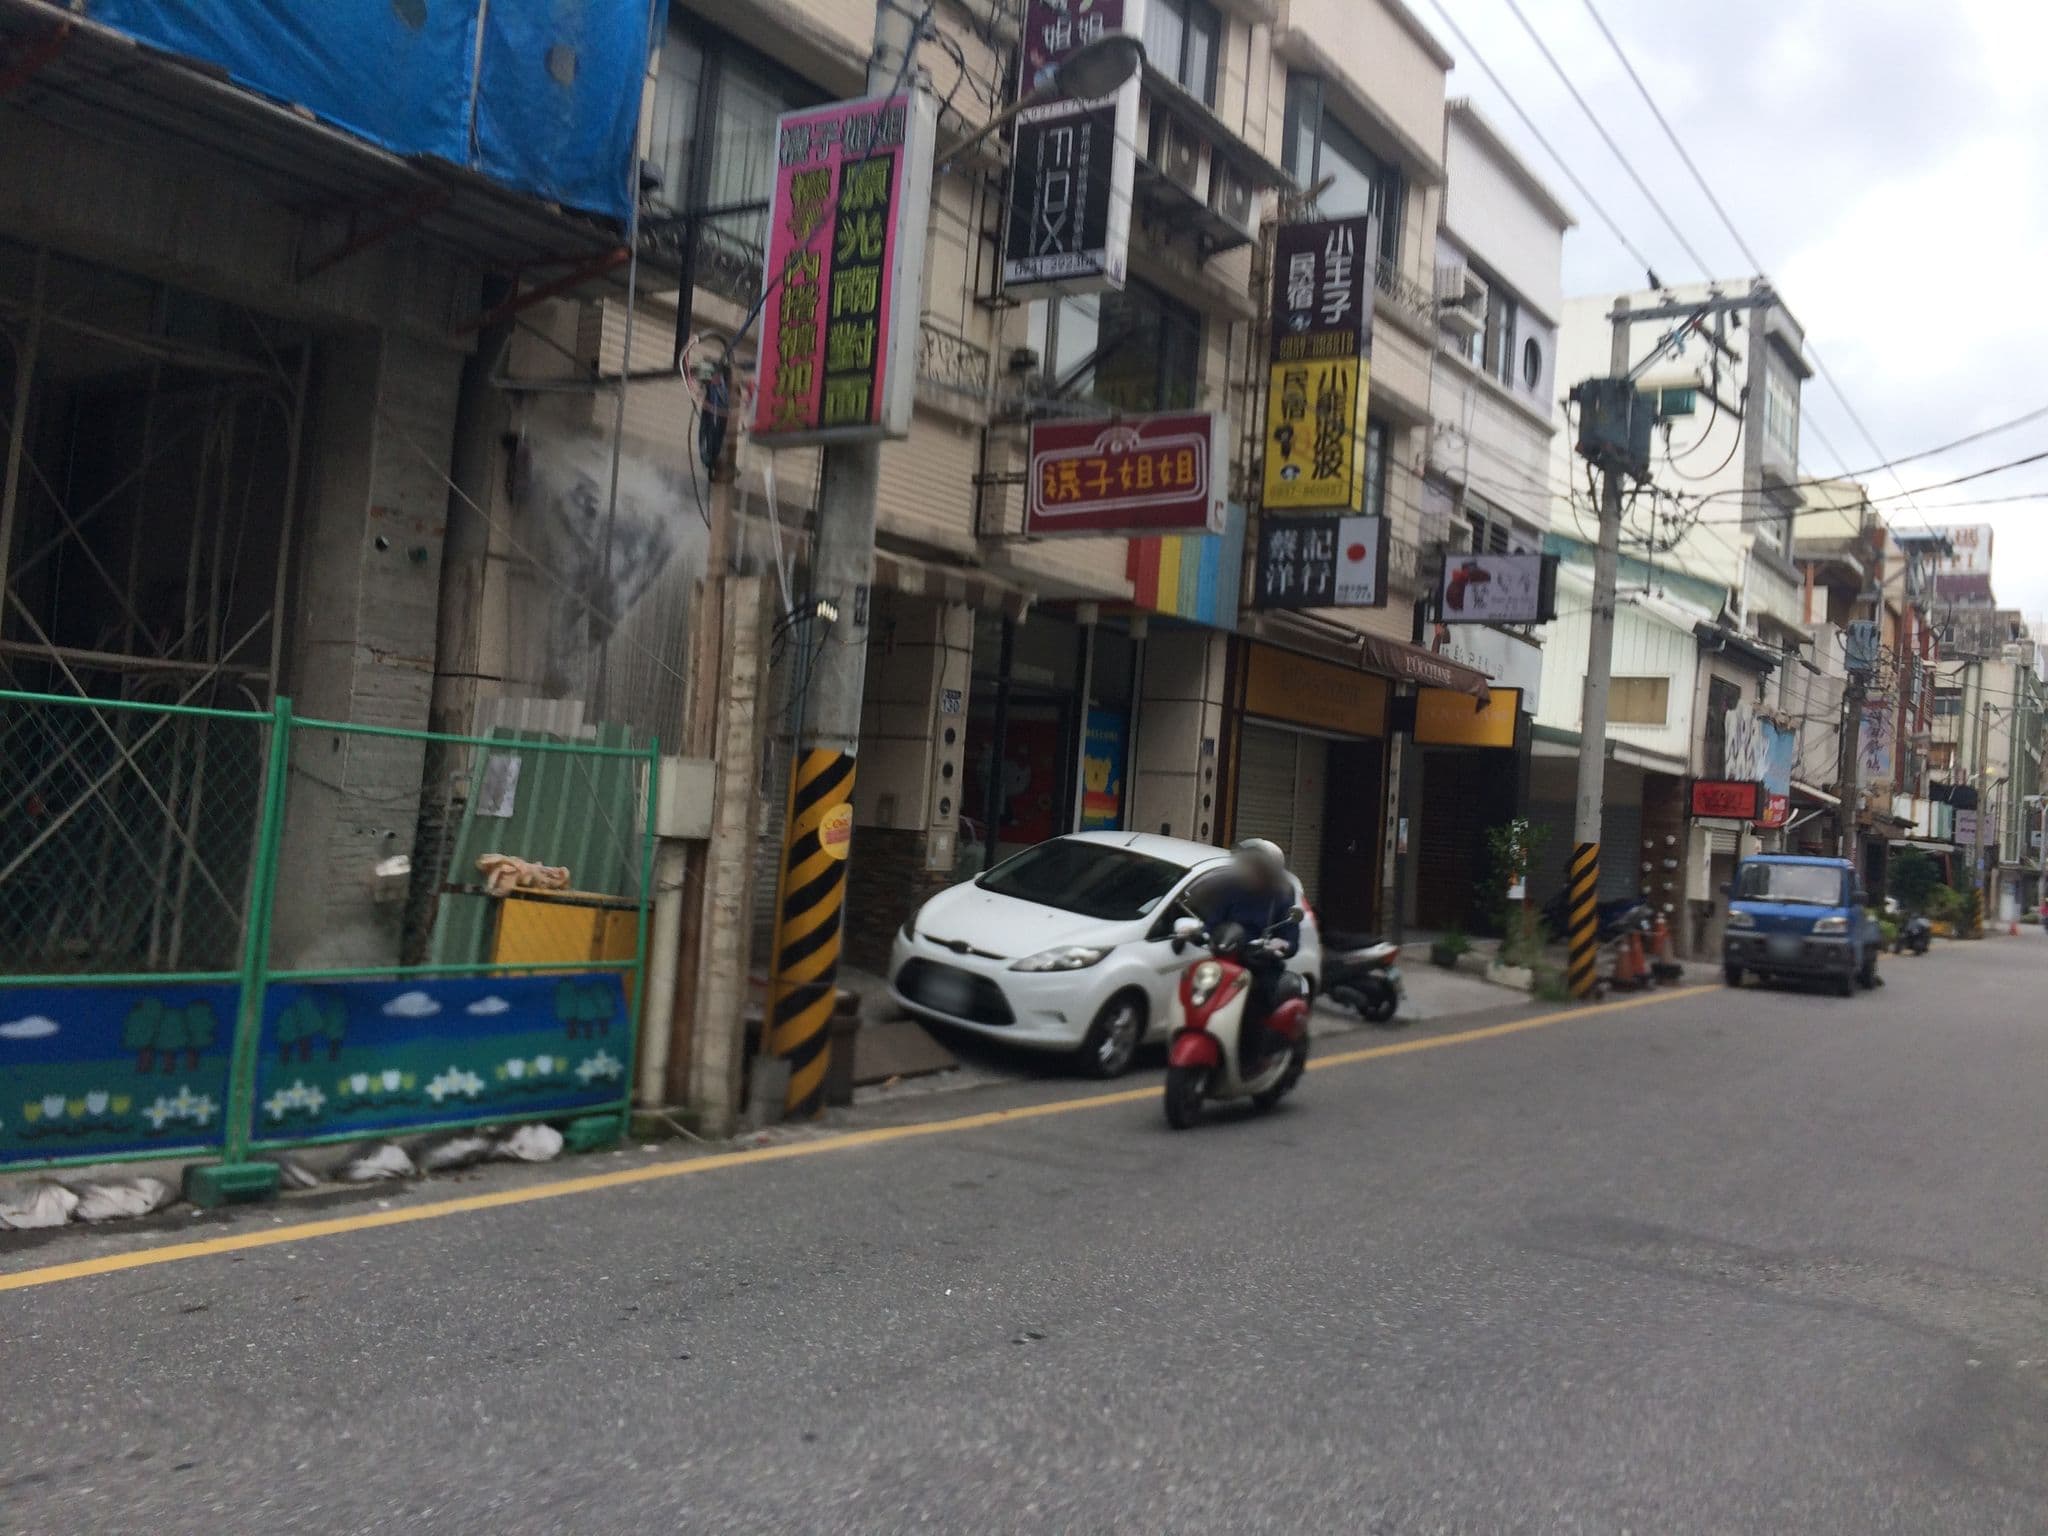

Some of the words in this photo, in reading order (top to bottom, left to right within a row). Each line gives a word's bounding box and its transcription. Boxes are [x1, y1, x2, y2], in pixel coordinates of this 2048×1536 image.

[1286, 253, 1316, 312] 民宿
[1320, 223, 1355, 325] 小王子
